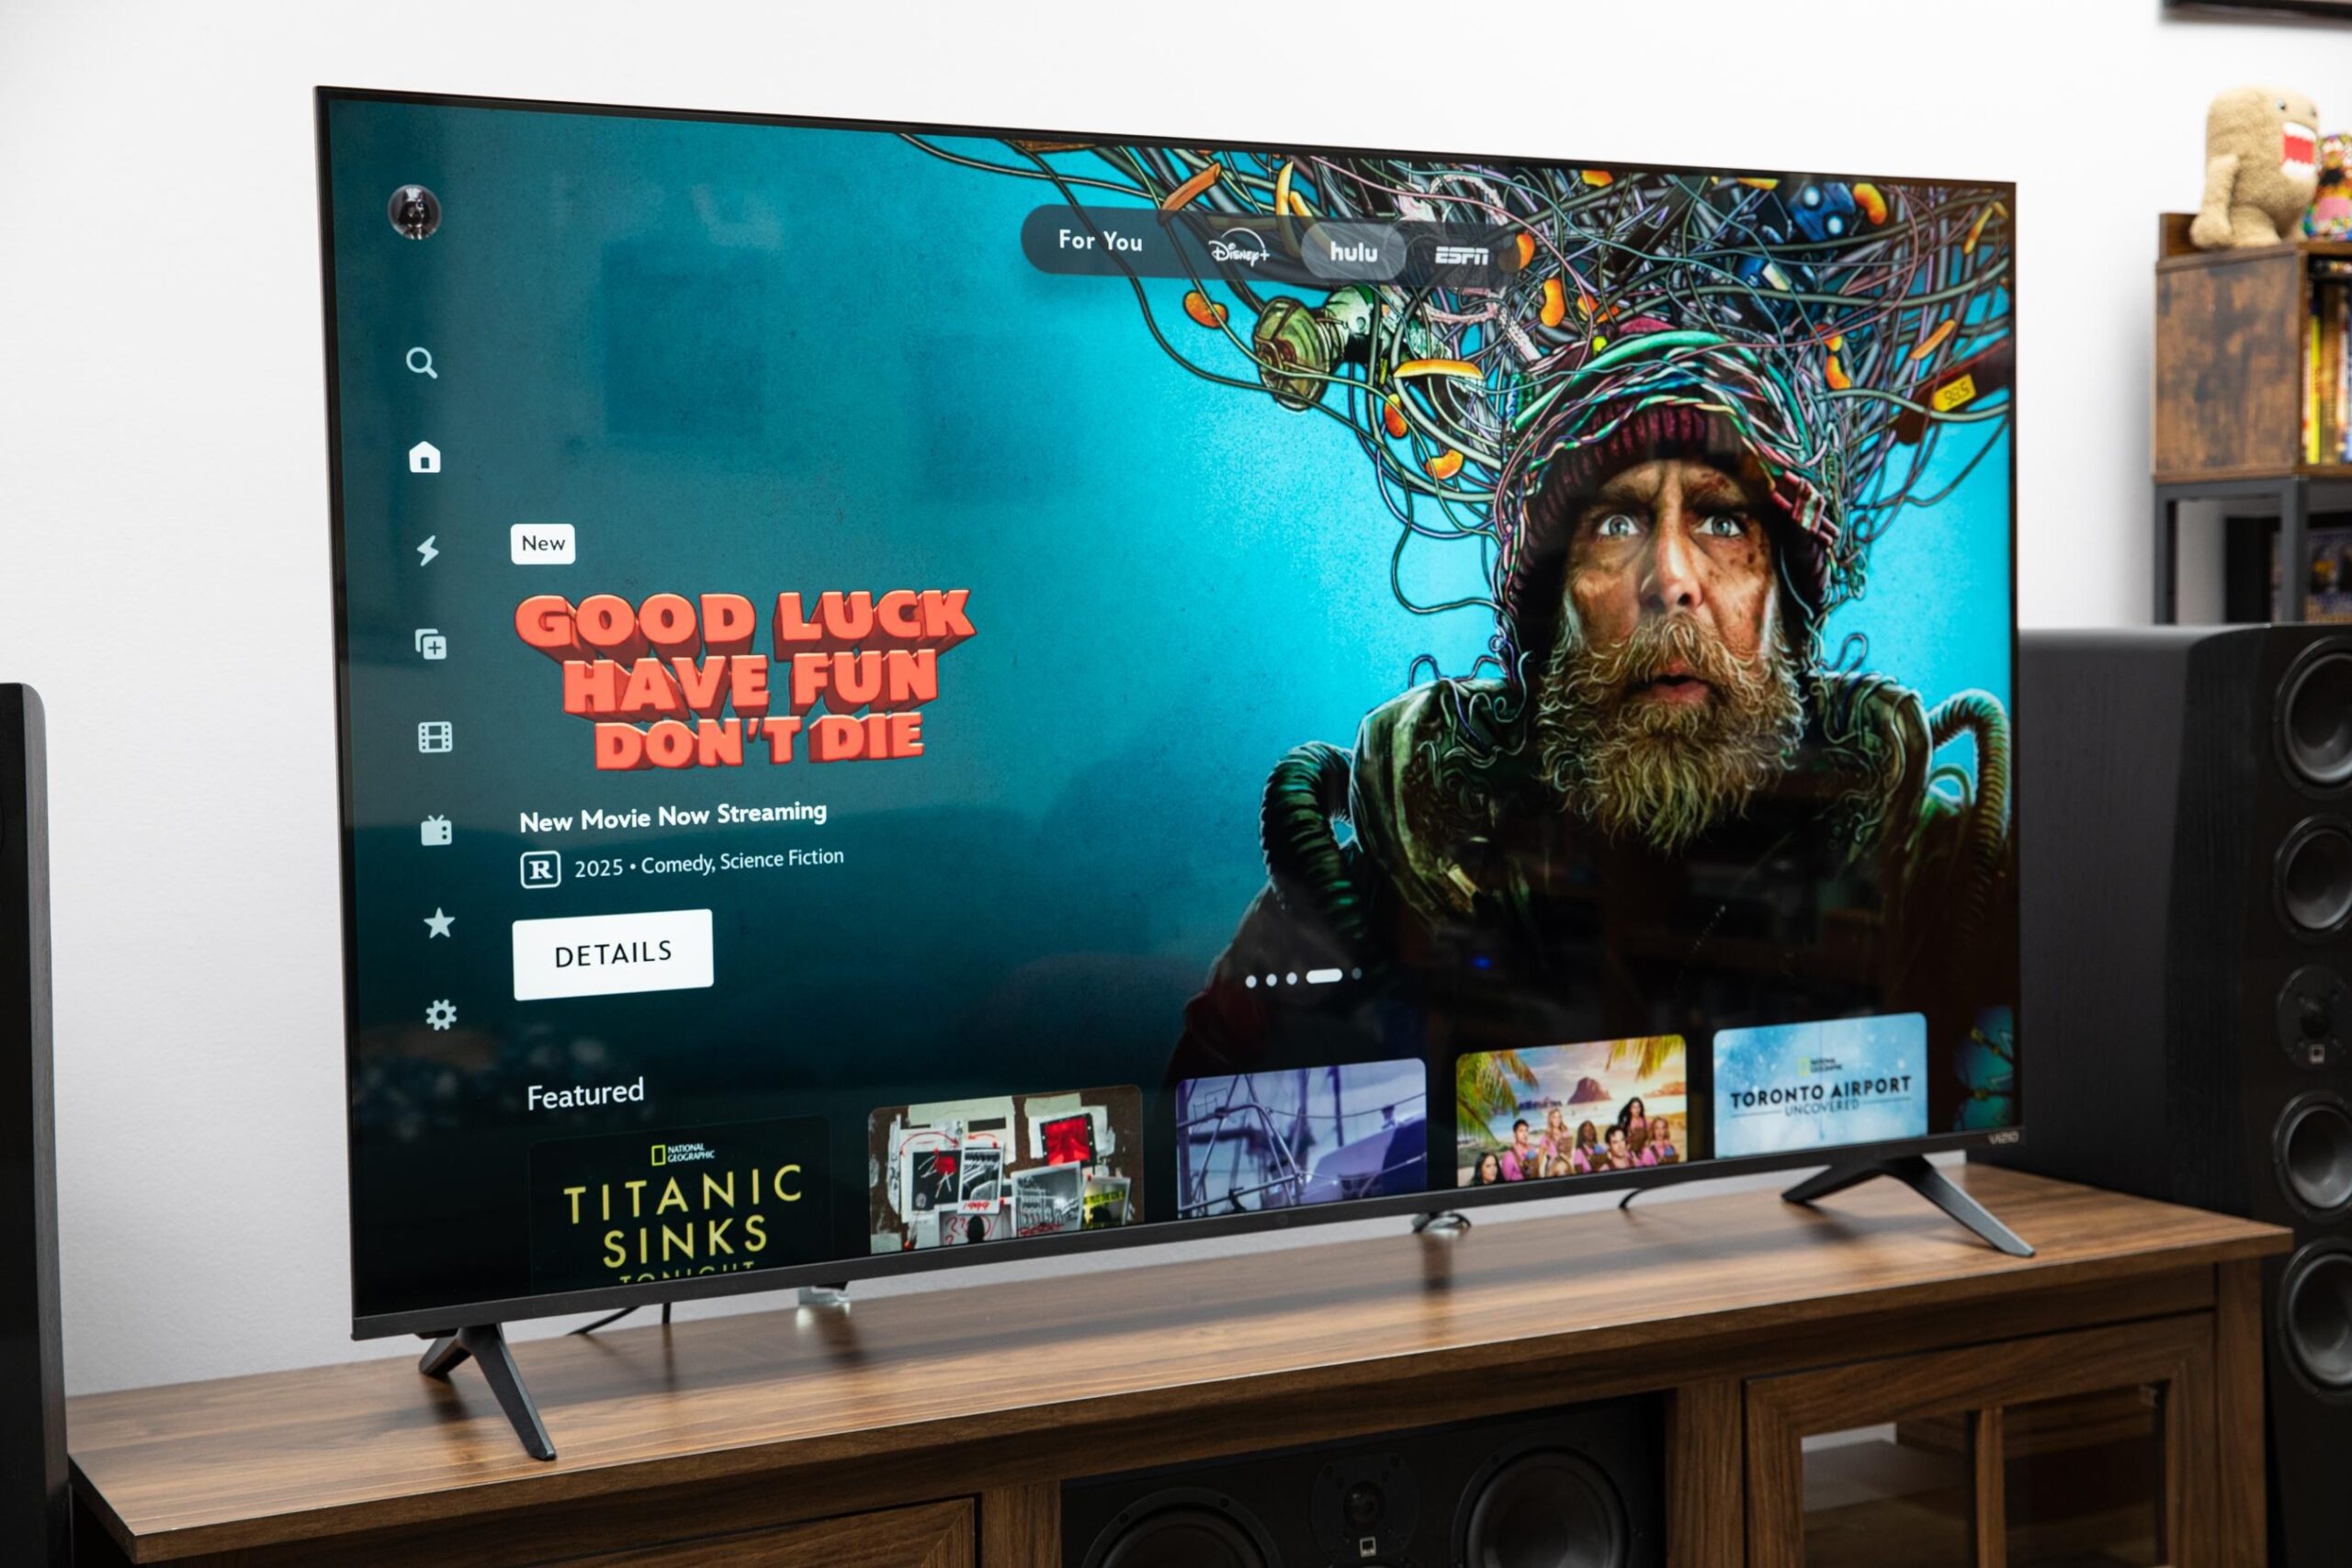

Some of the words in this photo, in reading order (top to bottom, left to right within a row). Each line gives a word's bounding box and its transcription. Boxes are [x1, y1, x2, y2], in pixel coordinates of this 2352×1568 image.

[1059, 229, 1095, 249] For
[1103, 231, 1142, 252] You
[1208, 227, 1270, 267] Disney+
[1330, 241, 1378, 263] hulu
[1435, 245, 1489, 265] ESPN
[522, 535, 566, 551] New
[514, 592, 756, 660] GOOD
[774, 589, 978, 660] LUCK
[562, 654, 770, 719] HAVE
[791, 649, 938, 716] FUN
[594, 716, 801, 770] DON'T
[808, 712, 924, 763] DIE
[520, 812, 572, 833] New
[581, 808, 650, 830] Movie
[659, 806, 710, 827] Now
[718, 801, 827, 825] Streaming
[528, 860, 553, 879] R
[574, 859, 623, 878] 2025
[641, 854, 716, 876] Comedy,
[720, 852, 784, 870] Science
[788, 849, 843, 866] Fiction
[555, 940, 672, 968] DETAILS
[527, 1077, 644, 1111] Featured
[1730, 1085, 1824, 1109] TORONTO
[1831, 1076, 1911, 1098] AIRPORT
[1784, 1099, 1860, 1117] UNCOVERED
[667, 1143, 705, 1155] NATIONAL
[667, 1150, 715, 1163] GEOGRAPHIC
[563, 1165, 802, 1224] TITANIC
[603, 1214, 767, 1269] SINKS
